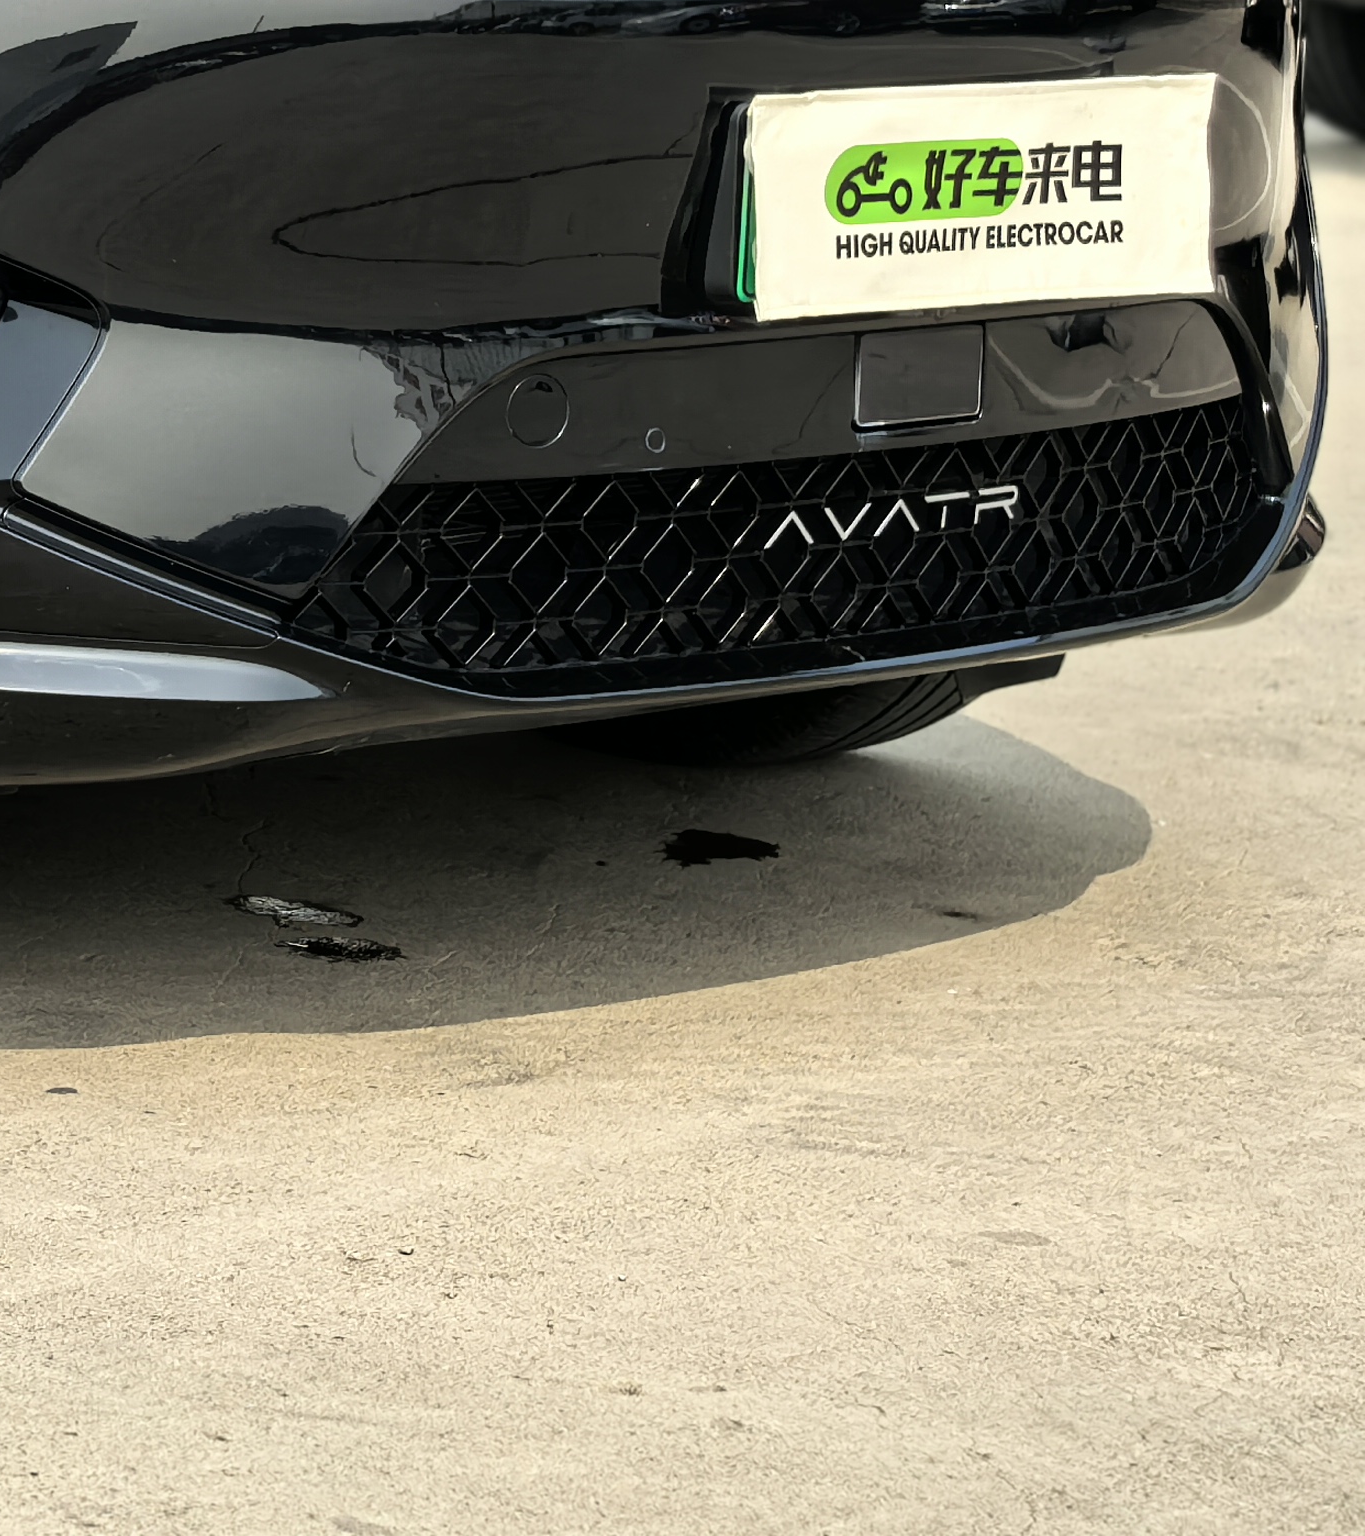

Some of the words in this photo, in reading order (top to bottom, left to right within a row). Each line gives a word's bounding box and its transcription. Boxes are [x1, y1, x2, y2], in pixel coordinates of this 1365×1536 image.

[921, 140, 1123, 210] 好车来电
[835, 231, 894, 260] HIGH
[899, 225, 981, 256] QUALITY
[985, 219, 1125, 250] ELECTROCAR
[764, 485, 1019, 550] AVATR
